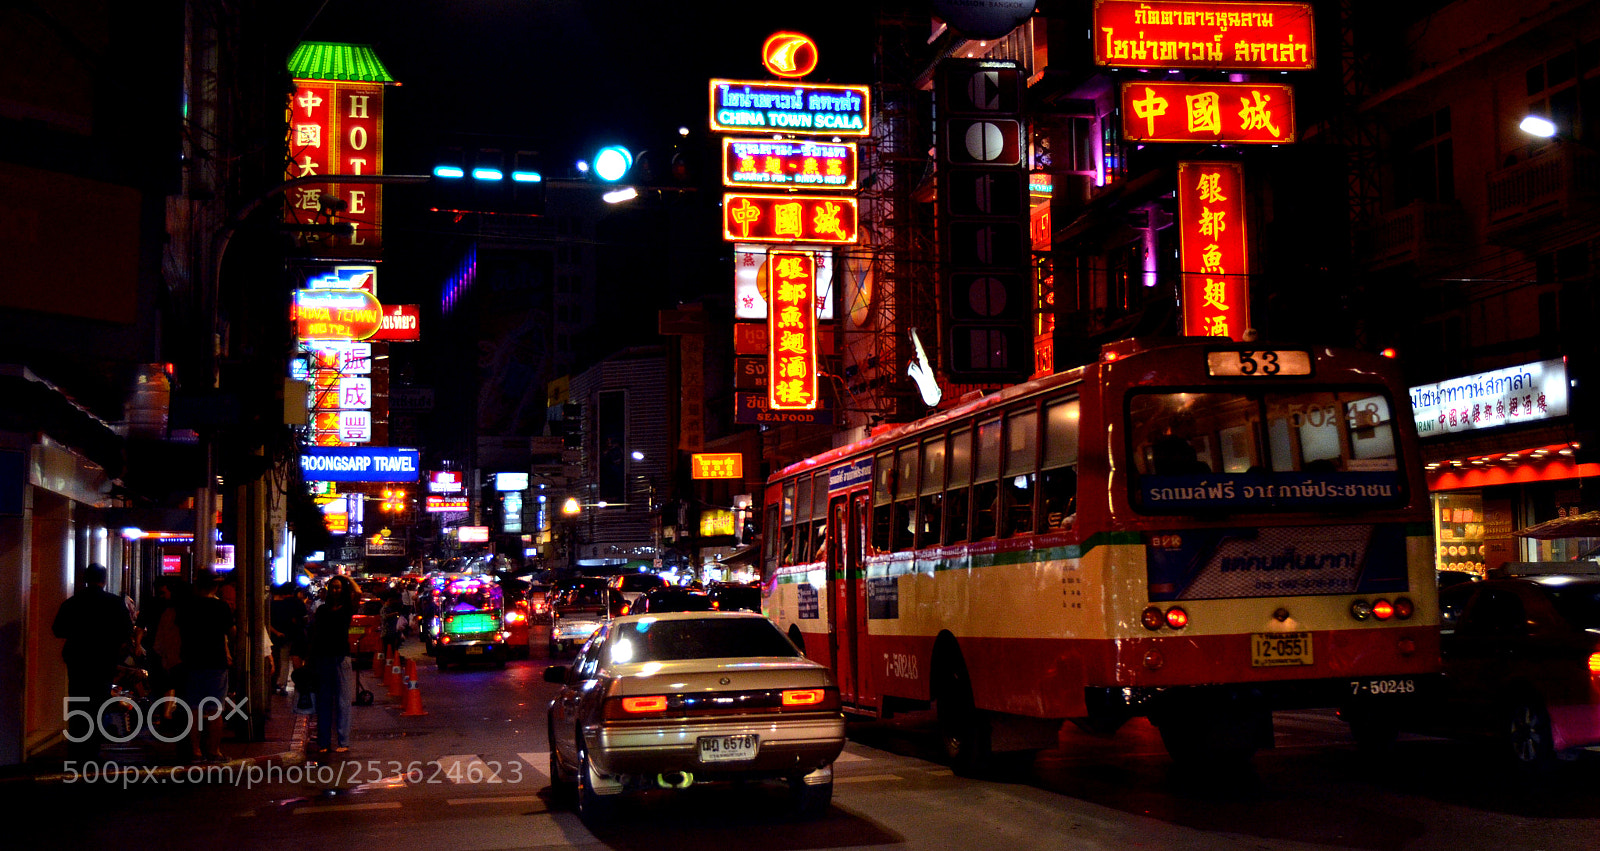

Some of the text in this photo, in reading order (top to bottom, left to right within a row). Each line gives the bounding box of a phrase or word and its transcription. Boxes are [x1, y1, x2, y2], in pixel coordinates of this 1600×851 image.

[1134, 3, 1274, 32] ภัตตาคารหูฉลาม
[1101, 27, 1308, 62] ไชน่าทาวน์ สกาล่า
[718, 111, 864, 129] CHINA TOWN SCALA
[1132, 87, 1280, 137] 中國城
[349, 95, 370, 246] HOTEL
[731, 198, 847, 240] 中國城
[1240, 351, 1281, 375] 53
[756, 413, 815, 422] SEAFOOD
[301, 455, 416, 472] ROONGSARP TRAVEL
[1150, 478, 1235, 501] รถเมล์ฟรี
[1279, 480, 1393, 499] ภาษีประชาชน
[1256, 639, 1309, 657] 12-0551
[883, 652, 919, 680] 7-50248
[1350, 679, 1416, 695] 7-50248
[723, 738, 752, 750] 6578
